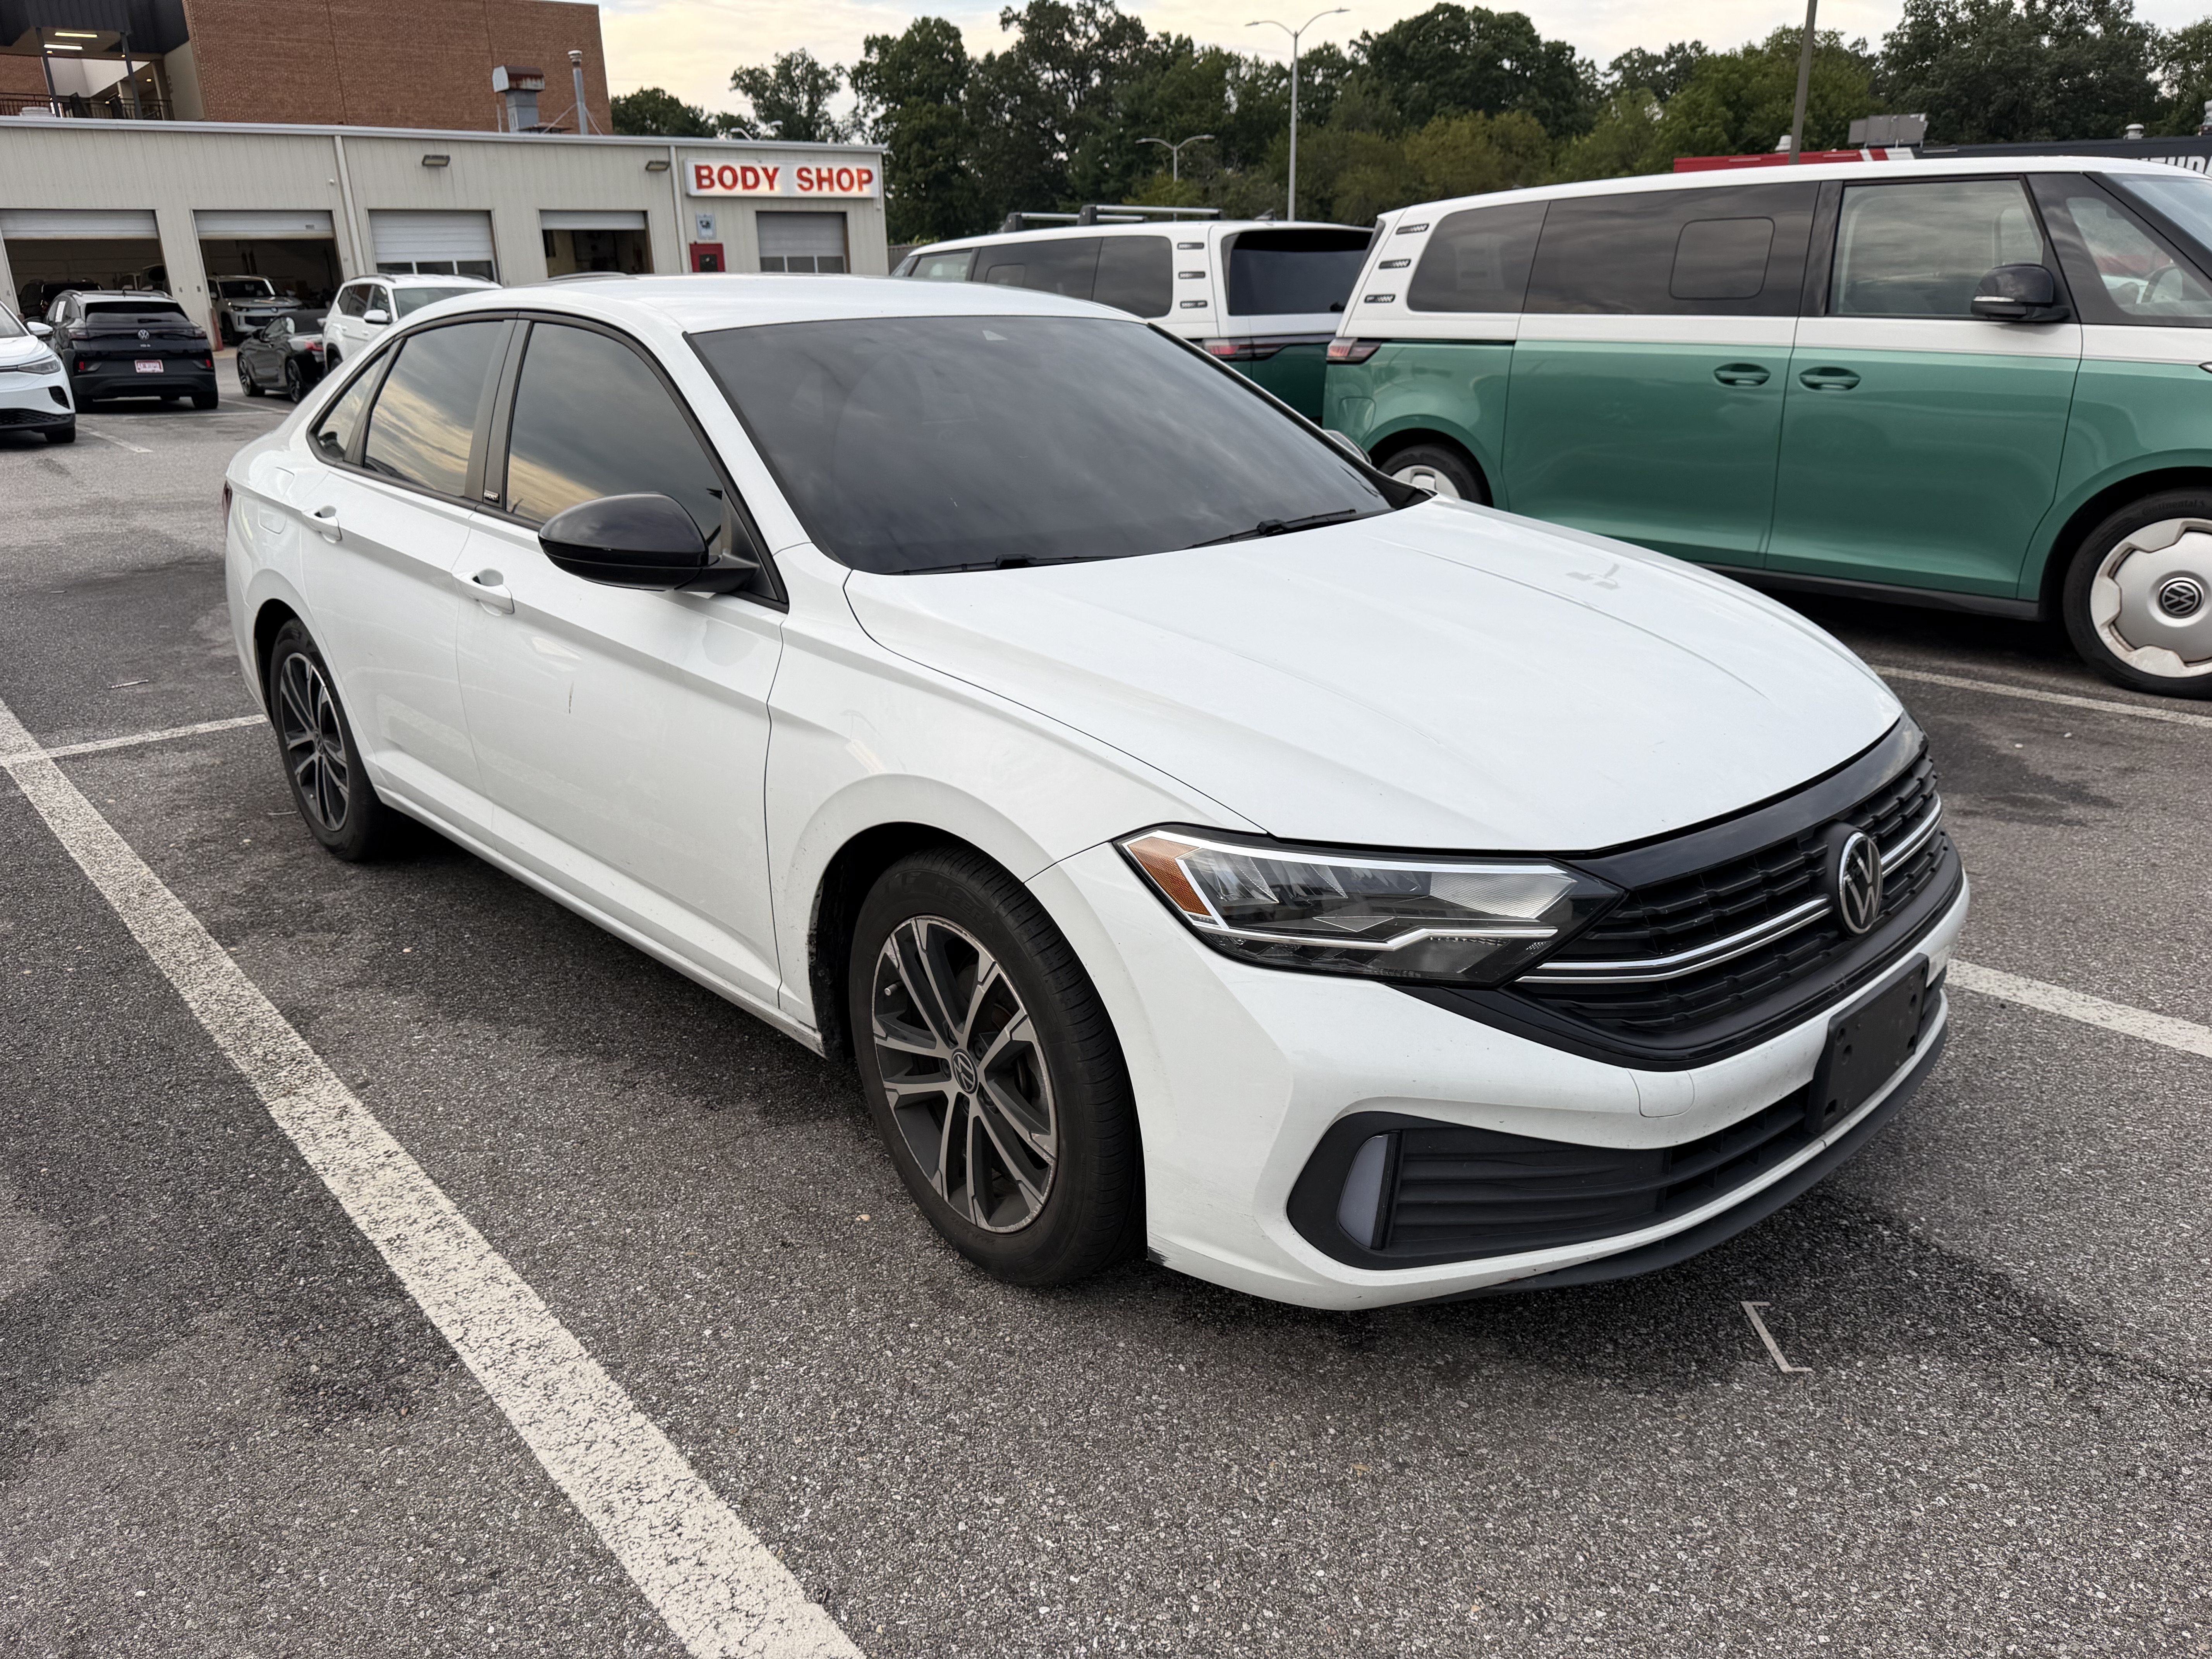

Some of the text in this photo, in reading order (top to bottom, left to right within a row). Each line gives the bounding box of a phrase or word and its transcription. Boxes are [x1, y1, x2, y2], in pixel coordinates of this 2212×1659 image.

[695, 165, 873, 192] BODY SHOP
[1841, 836, 1881, 930] VW
